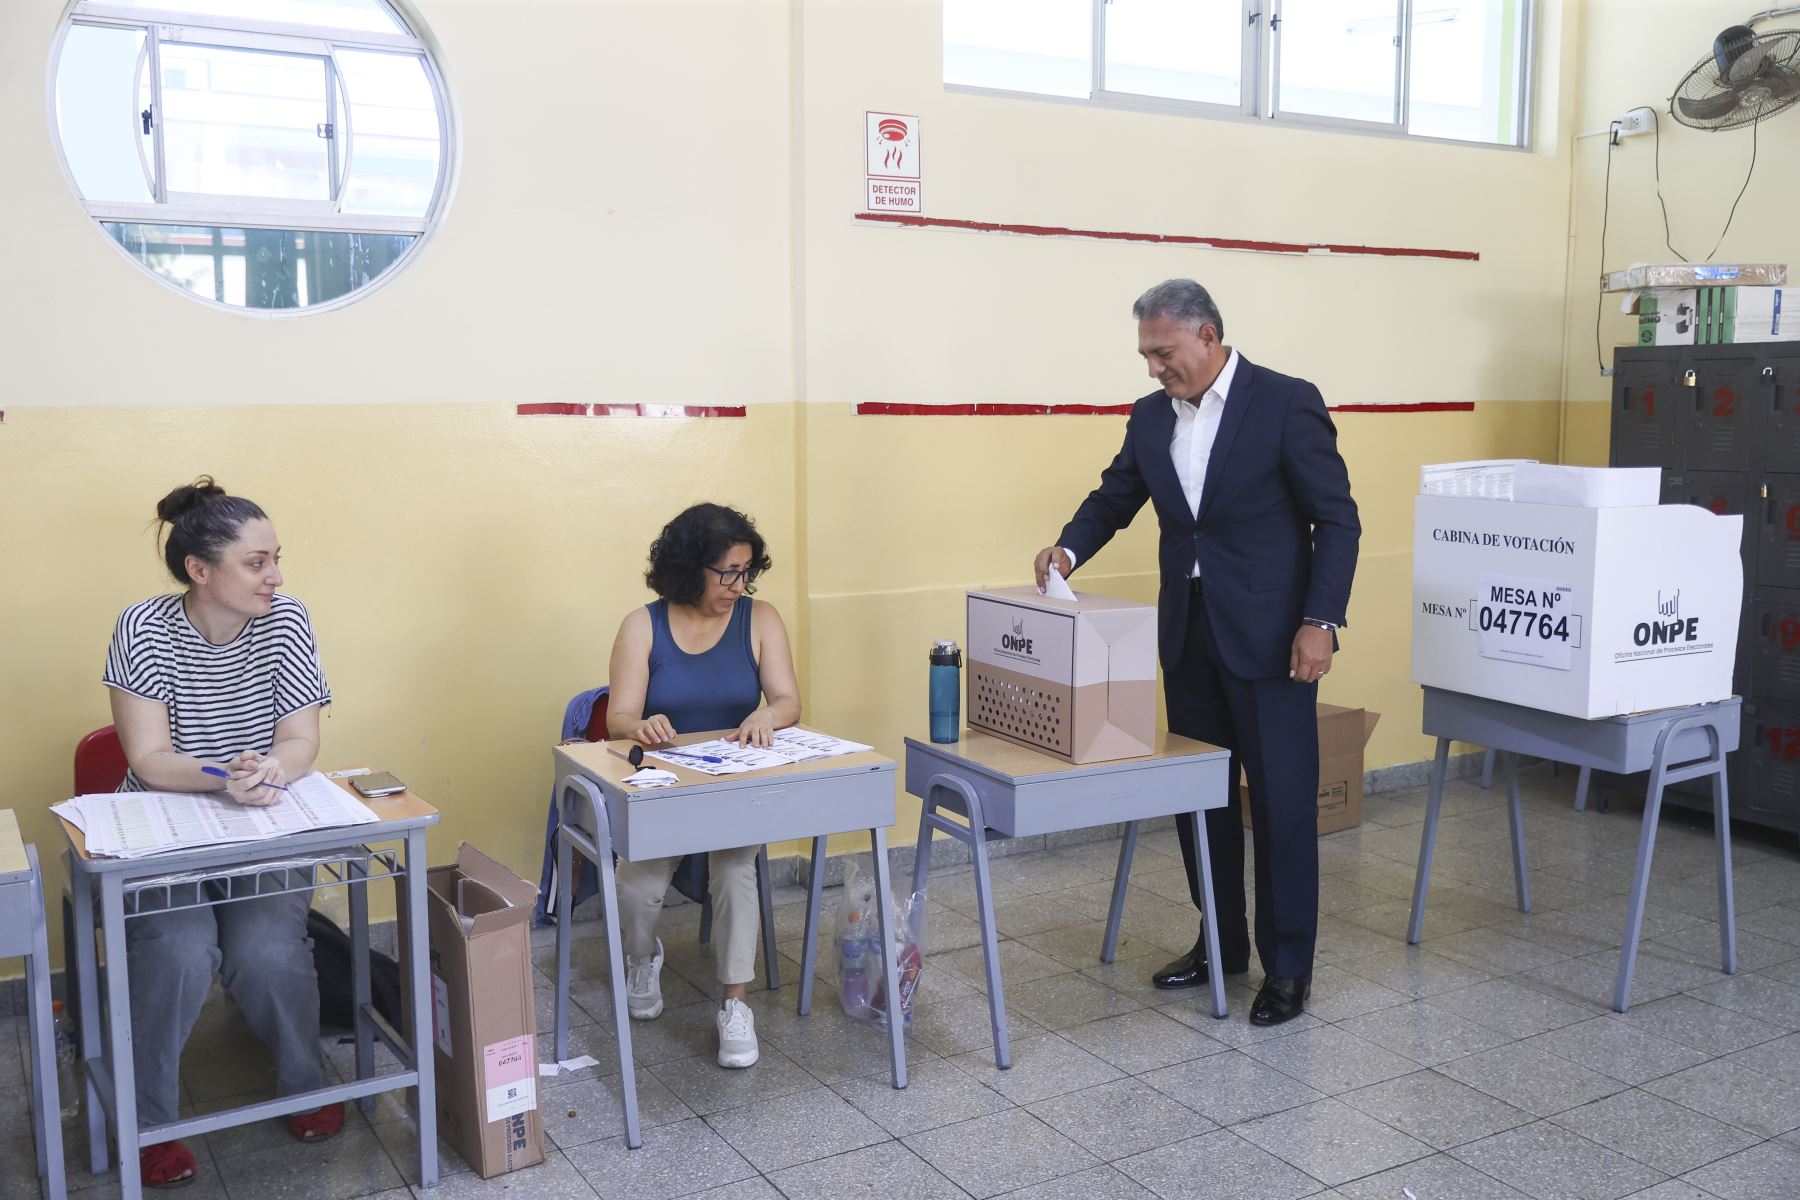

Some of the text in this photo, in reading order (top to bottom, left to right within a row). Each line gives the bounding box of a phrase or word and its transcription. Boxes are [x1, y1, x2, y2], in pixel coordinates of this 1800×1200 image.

[872, 185, 916, 195] DETECTOR
[875, 196, 914, 206] DE HUMO
[1641, 388, 1656, 417] 1
[1711, 387, 1736, 417] 2
[1433, 528, 1575, 555] CABINA DE VOTACIÓN
[1422, 602, 1453, 617] MESA
[1490, 586, 1537, 607] MESA
[1479, 606, 1570, 642] 047764
[1633, 617, 1699, 647] ONPE
[1779, 616, 1800, 649] 9
[1001, 633, 1033, 655] ONPE
[1614, 651, 1633, 659] Oficina
[1633, 648, 1655, 657] Nacional
[1663, 645, 1686, 653] Procesos
[1686, 643, 1714, 651] Electorales
[511, 1112, 527, 1151] NPE
